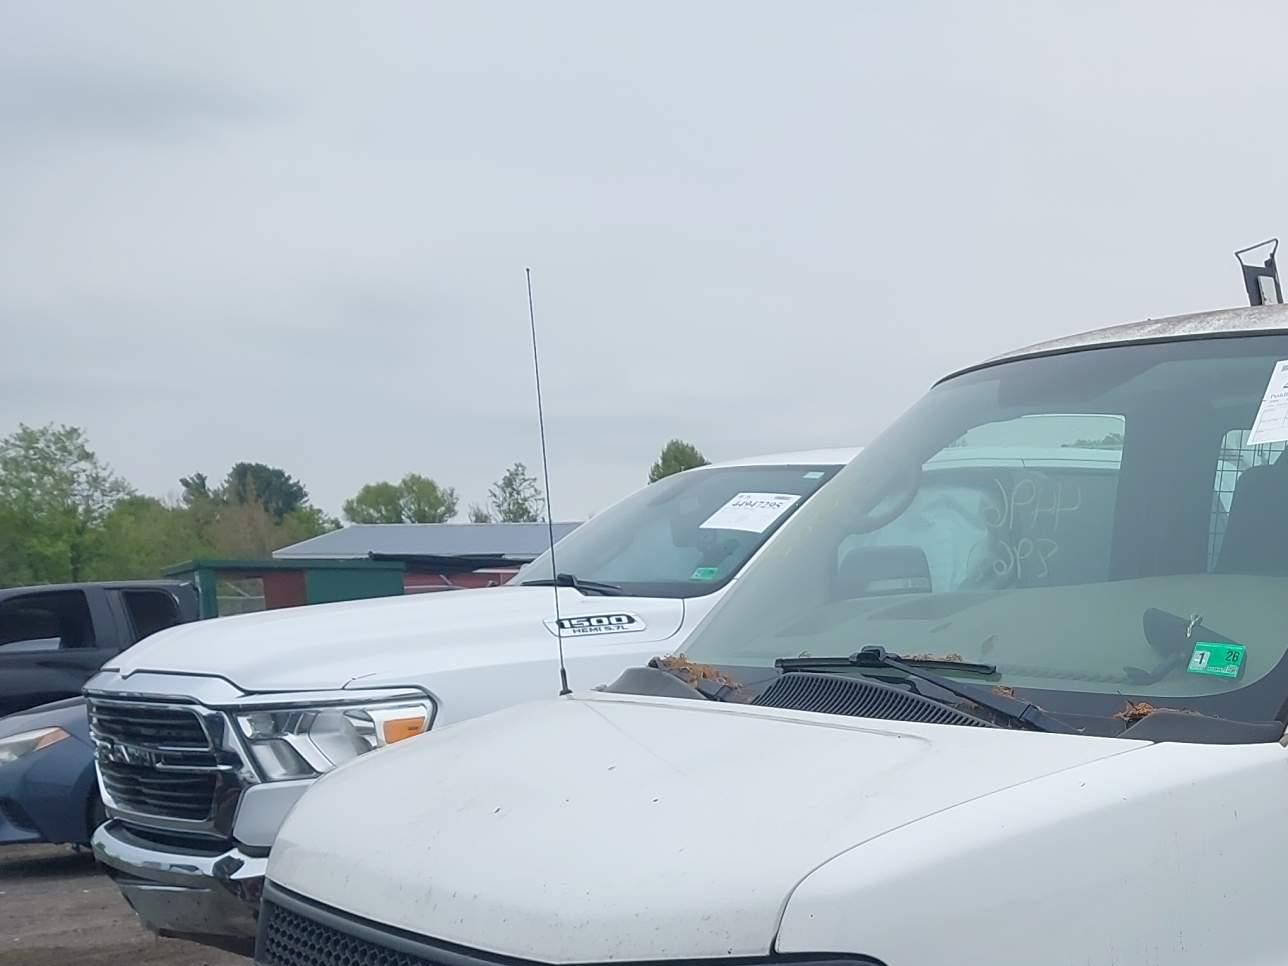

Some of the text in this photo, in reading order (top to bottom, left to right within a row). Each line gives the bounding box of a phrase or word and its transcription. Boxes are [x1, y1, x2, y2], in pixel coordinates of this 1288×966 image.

[560, 615, 629, 628] 1500
[572, 626, 602, 634] HEMI
[1198, 652, 1206, 665] 1
